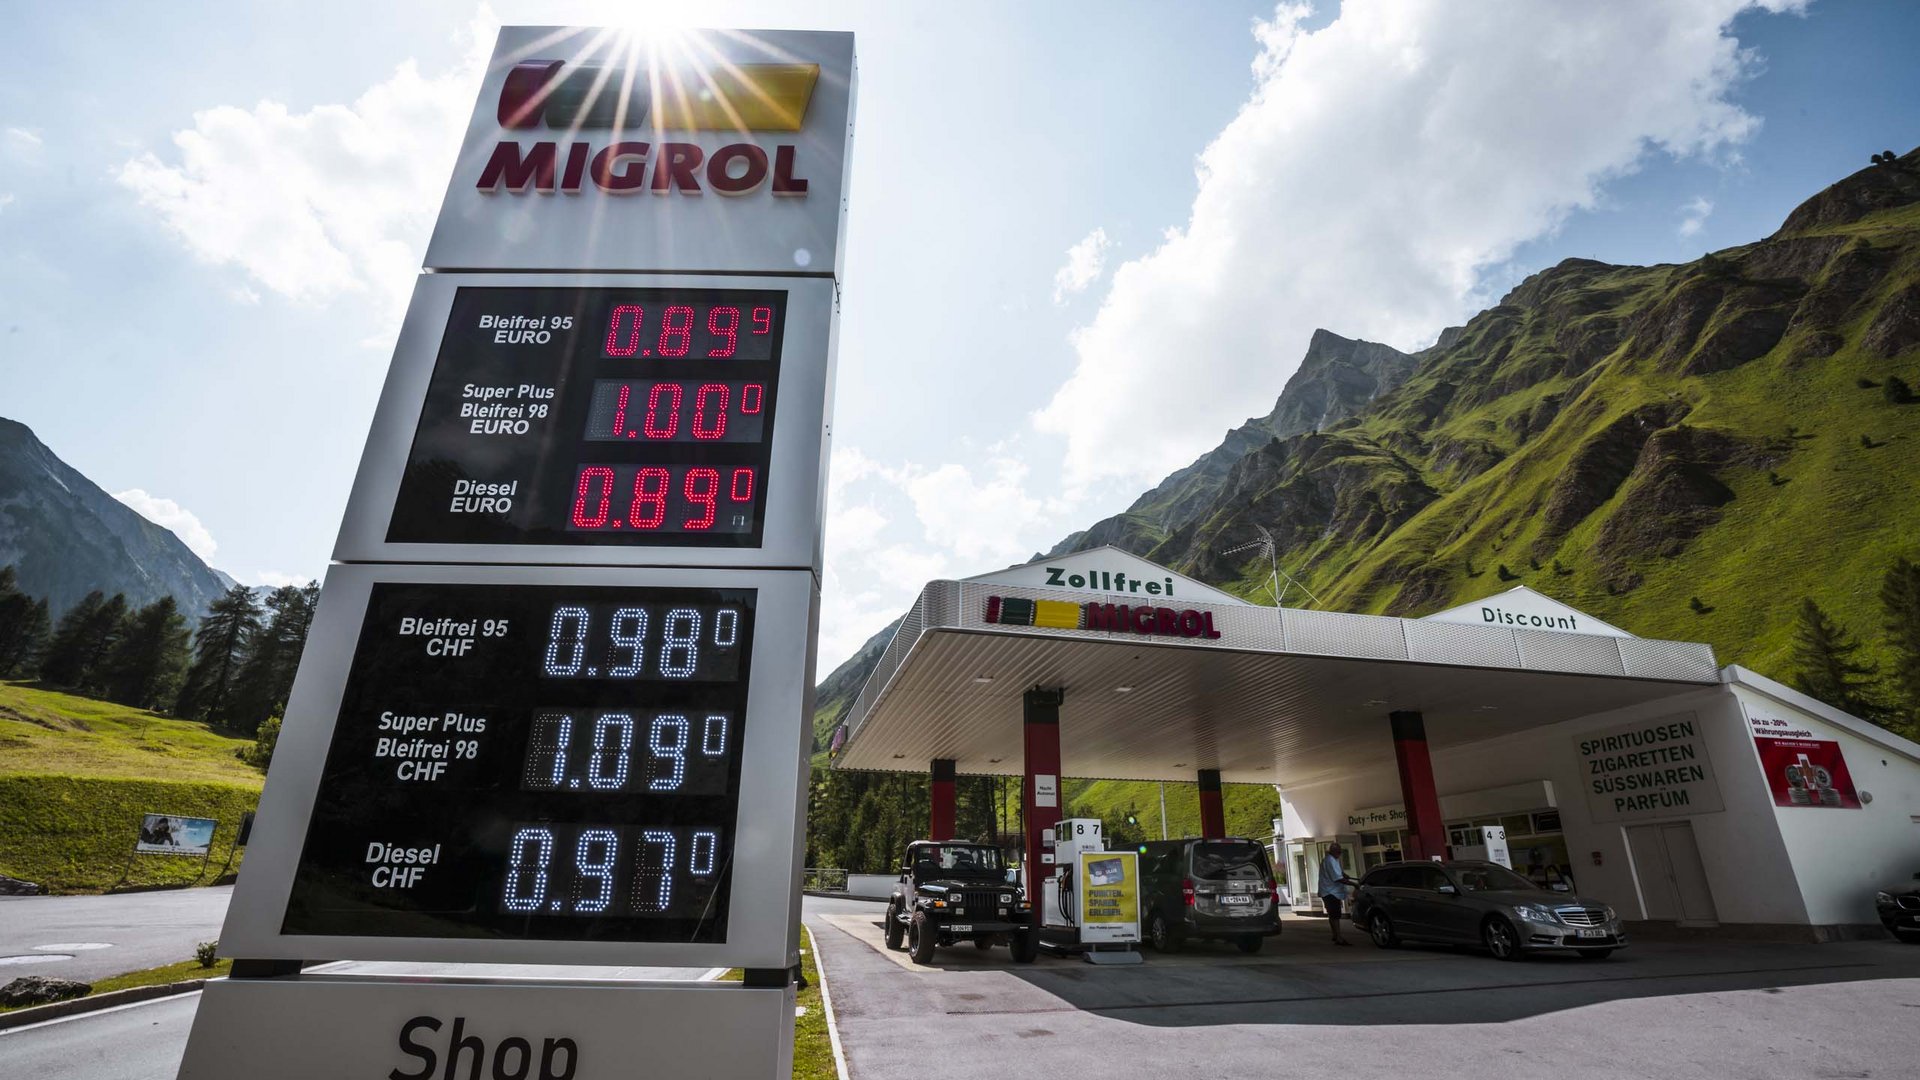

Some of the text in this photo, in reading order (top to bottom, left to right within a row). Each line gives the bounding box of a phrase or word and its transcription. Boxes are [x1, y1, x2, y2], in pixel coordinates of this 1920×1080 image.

[476, 141, 809, 198] MIGROL
[478, 315, 573, 331] Bleifrei 95
[494, 330, 551, 344] EURO
[462, 383, 555, 402] Super Plus
[460, 403, 548, 419] Bleifrei 98
[470, 419, 529, 434] EURO
[453, 480, 517, 496] Diesel
[449, 497, 512, 513] EURO
[1045, 567, 1174, 596] Zollfrei
[399, 617, 509, 637] Bleifrei 95
[1087, 602, 1221, 639] MIGROL
[1481, 607, 1577, 630] Discount
[426, 638, 474, 657] CHF
[378, 711, 486, 734] Super Plus
[1751, 717, 1761, 726] bis
[1580, 721, 1694, 756] SPIRITUOSEN
[1754, 727, 1812, 737] Währungsausgleich
[375, 738, 479, 760] Bleifrei 98
[1589, 744, 1694, 775] ZIGARETTEN
[396, 762, 448, 782] CHF
[1592, 764, 1705, 794] SÜSSWAREN
[1615, 788, 1690, 813] PARFÜM
[1348, 812, 1387, 826] Duty-Free
[1076, 824, 1100, 835] 8 7
[1486, 830, 1505, 840] 4 3
[365, 842, 441, 864] Diesel
[372, 867, 425, 889] CHF
[389, 1015, 578, 1080] Shop
